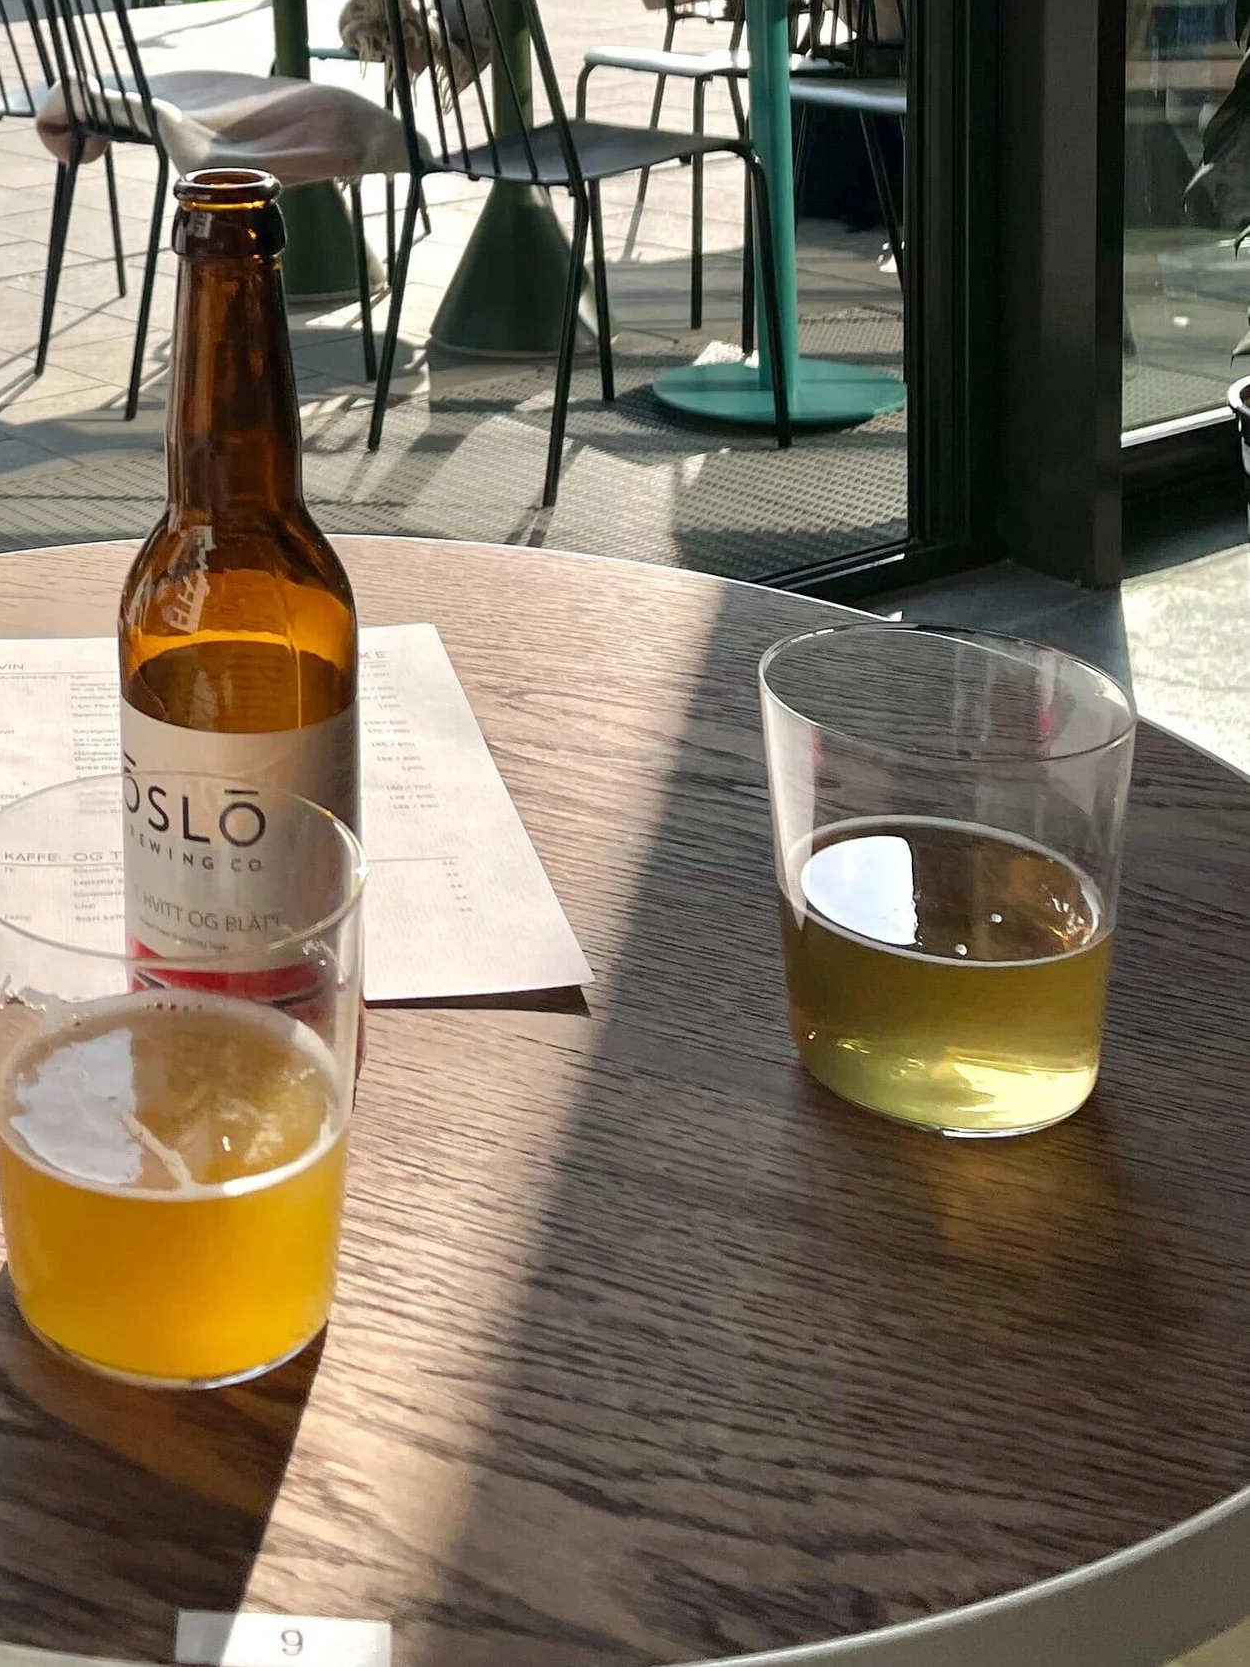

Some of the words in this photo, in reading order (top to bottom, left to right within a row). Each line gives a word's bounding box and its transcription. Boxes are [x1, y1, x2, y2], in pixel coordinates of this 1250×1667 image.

[4, 851, 57, 862] KAFFE
[73, 851, 103, 862] OG
[230, 858, 263, 872] CO
[188, 910, 218, 932] OG
[280, 1628, 304, 1657] 9
